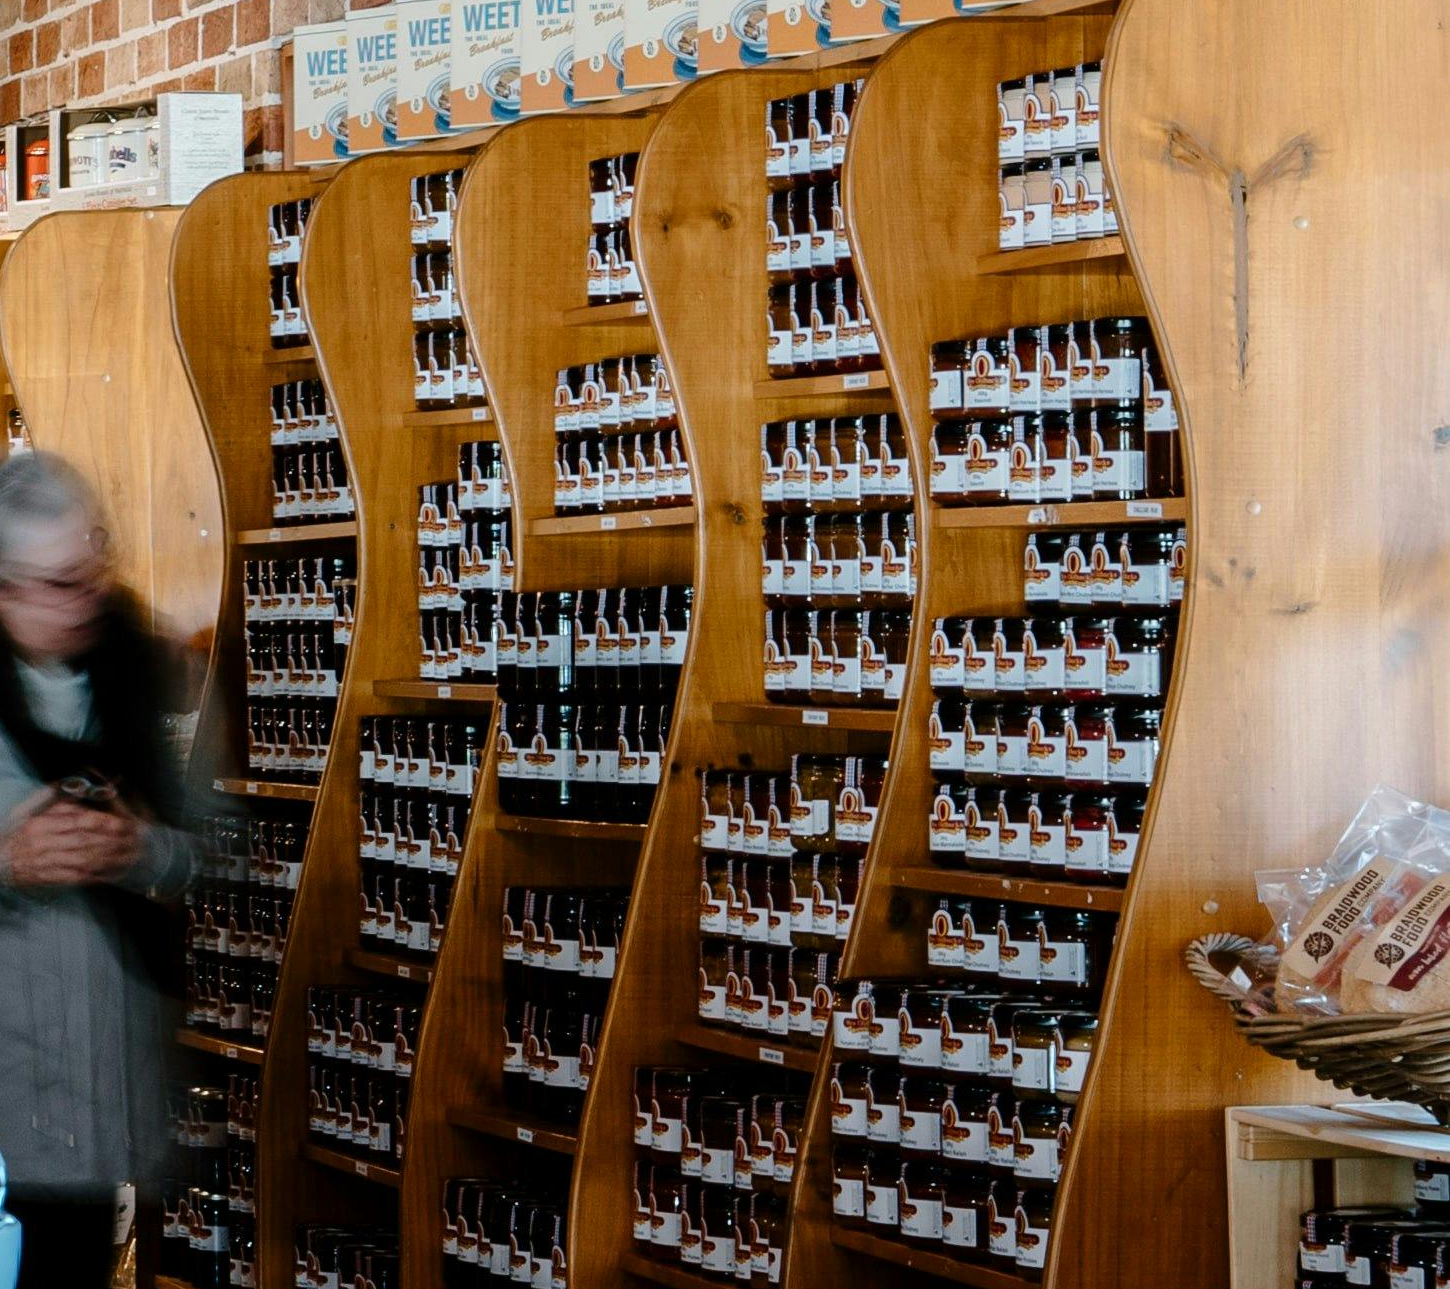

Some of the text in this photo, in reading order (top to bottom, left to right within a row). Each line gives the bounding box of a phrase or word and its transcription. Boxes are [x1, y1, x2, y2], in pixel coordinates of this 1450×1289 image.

[463, 1, 520, 32] WEET
[470, 33, 514, 57] Breakfast
[1322, 869, 1379, 930] BRAIDWOOD
[1333, 878, 1386, 935] FOOD COMPANY
[1390, 884, 1445, 942] BRAIDWOOD
[1402, 917, 1428, 948] FOOD
